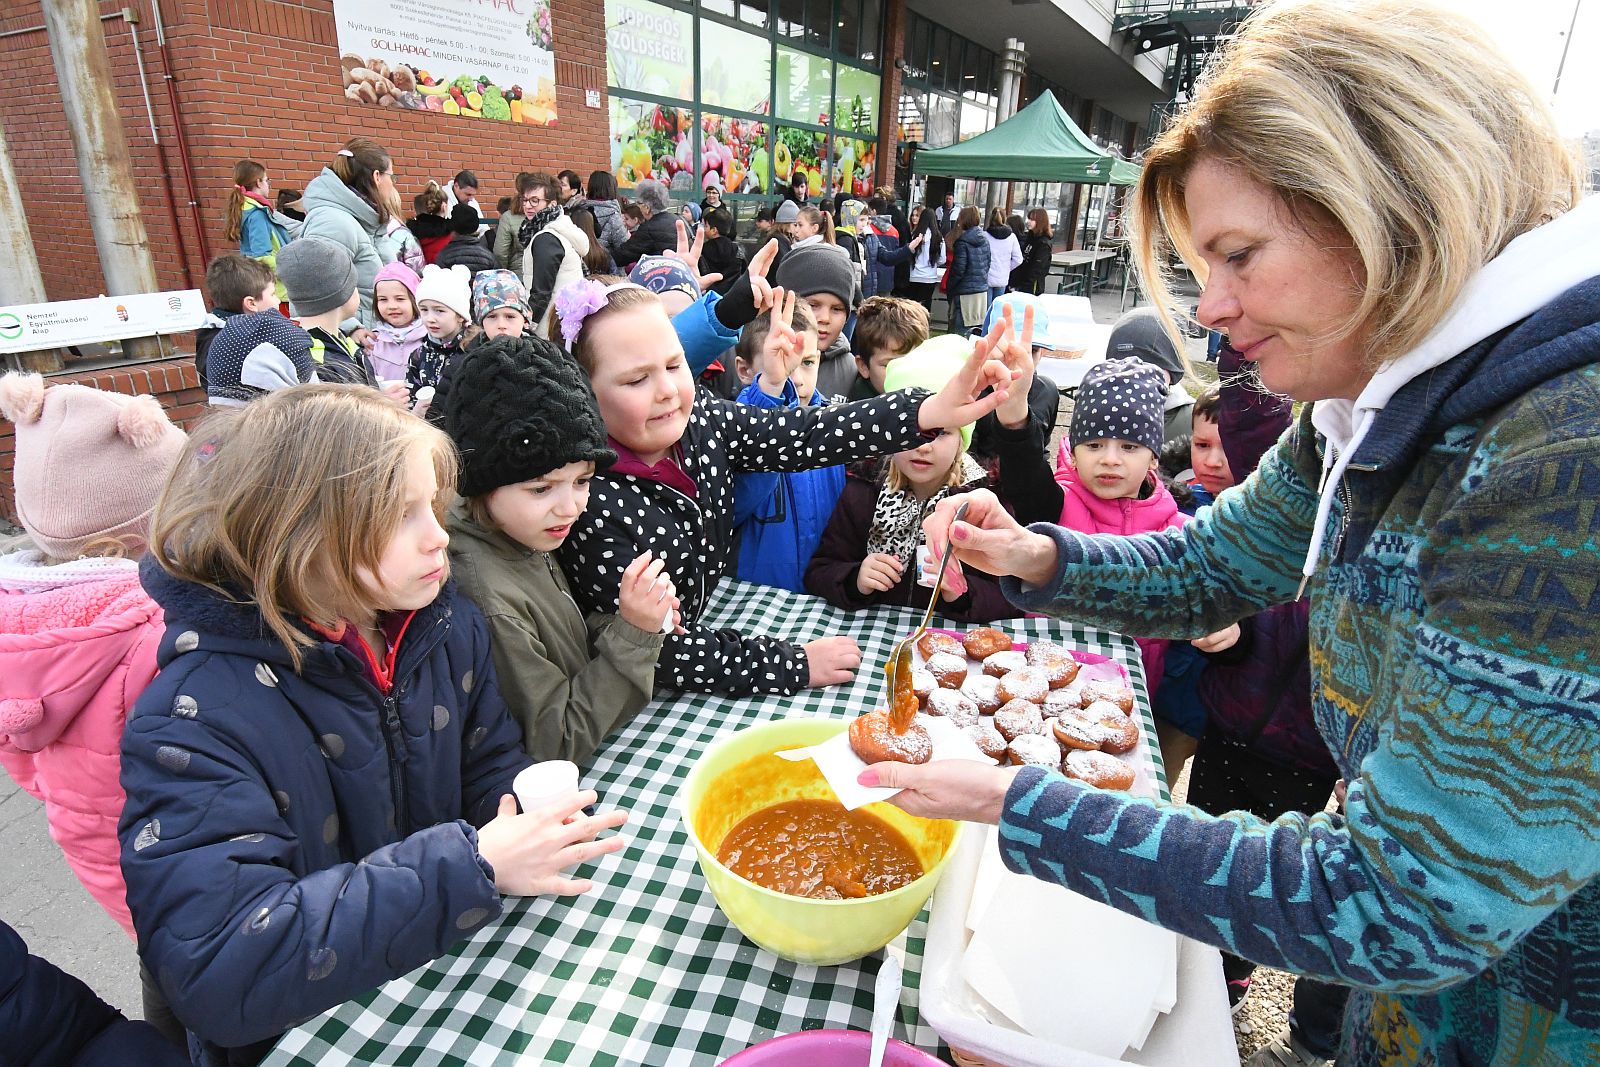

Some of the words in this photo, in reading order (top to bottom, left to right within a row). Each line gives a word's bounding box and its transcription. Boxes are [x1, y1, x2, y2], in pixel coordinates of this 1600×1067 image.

[347, 21, 373, 32] Nyitva
[425, 35, 448, 46] péntek
[612, 27, 685, 64] ZÖLDSÉGEK
[370, 38, 431, 58] BOLHAPIAC
[432, 51, 463, 63] MINDEN
[26, 311, 58, 320] Nemzeti
[32, 327, 50, 335] Alap
